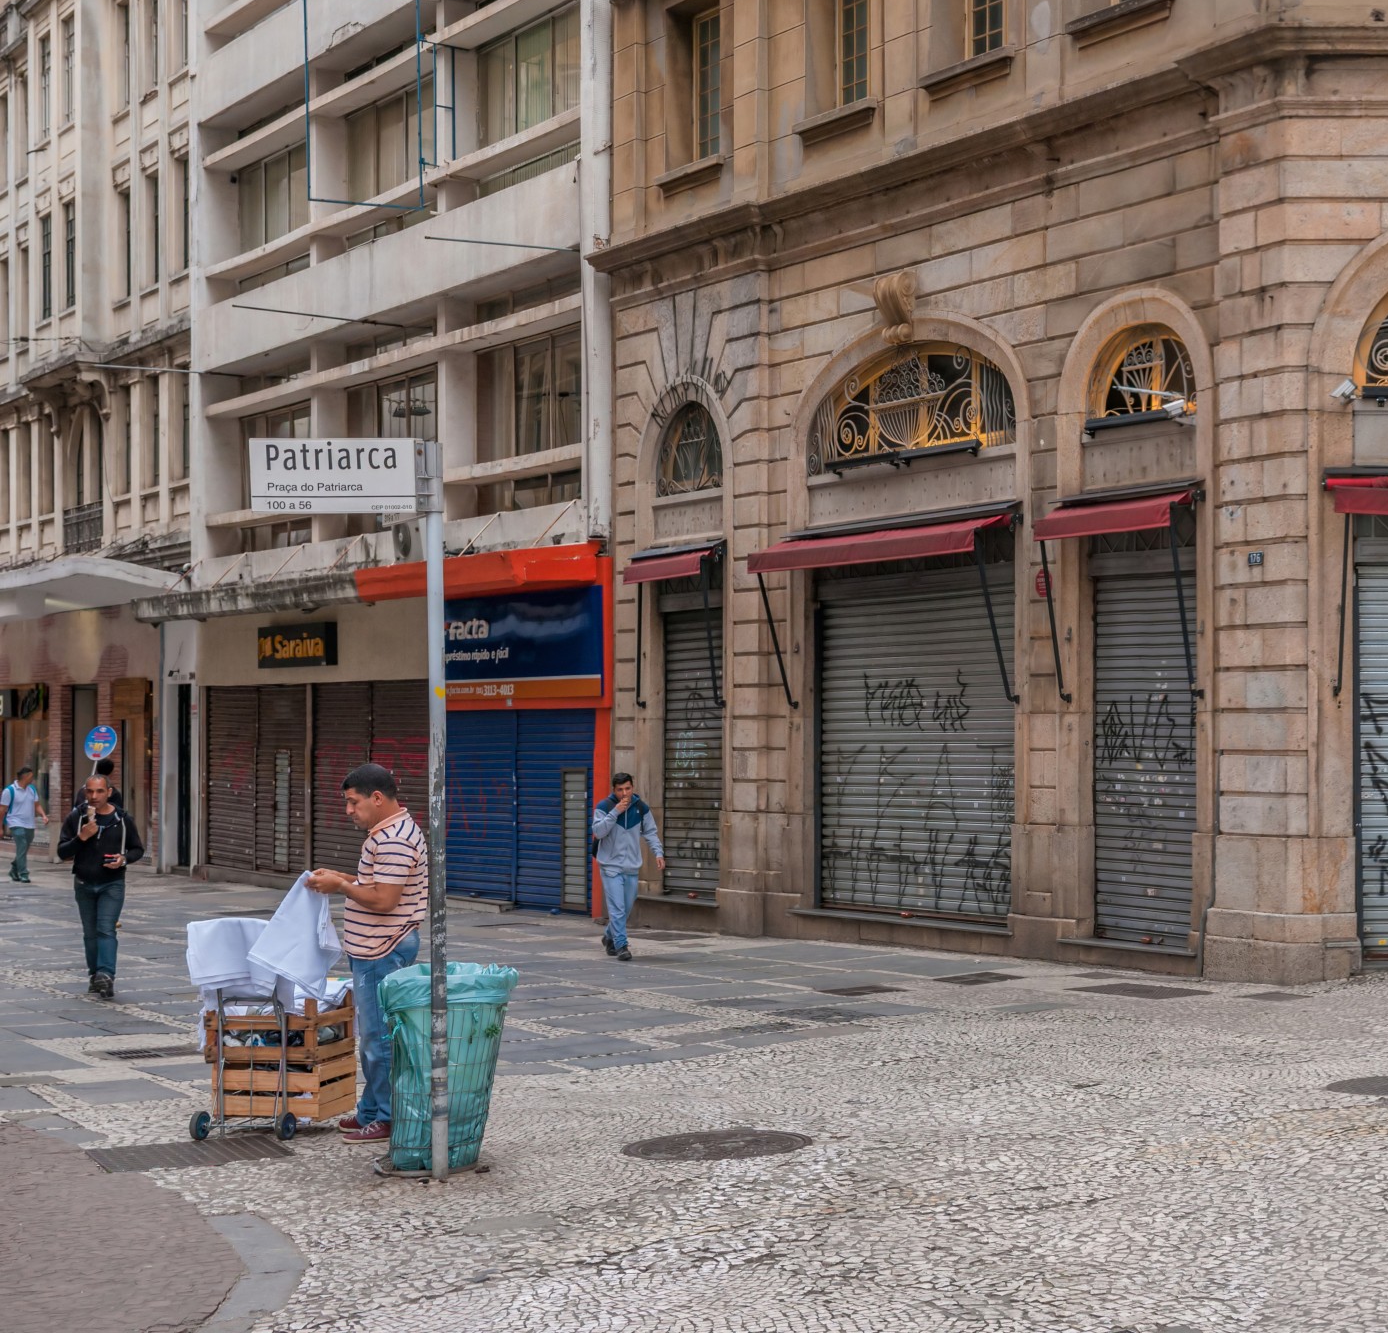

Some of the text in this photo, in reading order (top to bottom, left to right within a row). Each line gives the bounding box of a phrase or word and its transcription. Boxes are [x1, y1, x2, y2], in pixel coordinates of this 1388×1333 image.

[265, 441, 397, 471] Patriarca
[267, 482, 363, 493] Praça do Patriarca
[266, 501, 312, 510] 100 a 56
[1250, 553, 1261, 564] 176
[448, 618, 489, 640] facta
[273, 632, 324, 659] Saraiva
[472, 648, 490, 663] rápido
[491, 651, 497, 660] e
[495, 646, 509, 664] fácil
